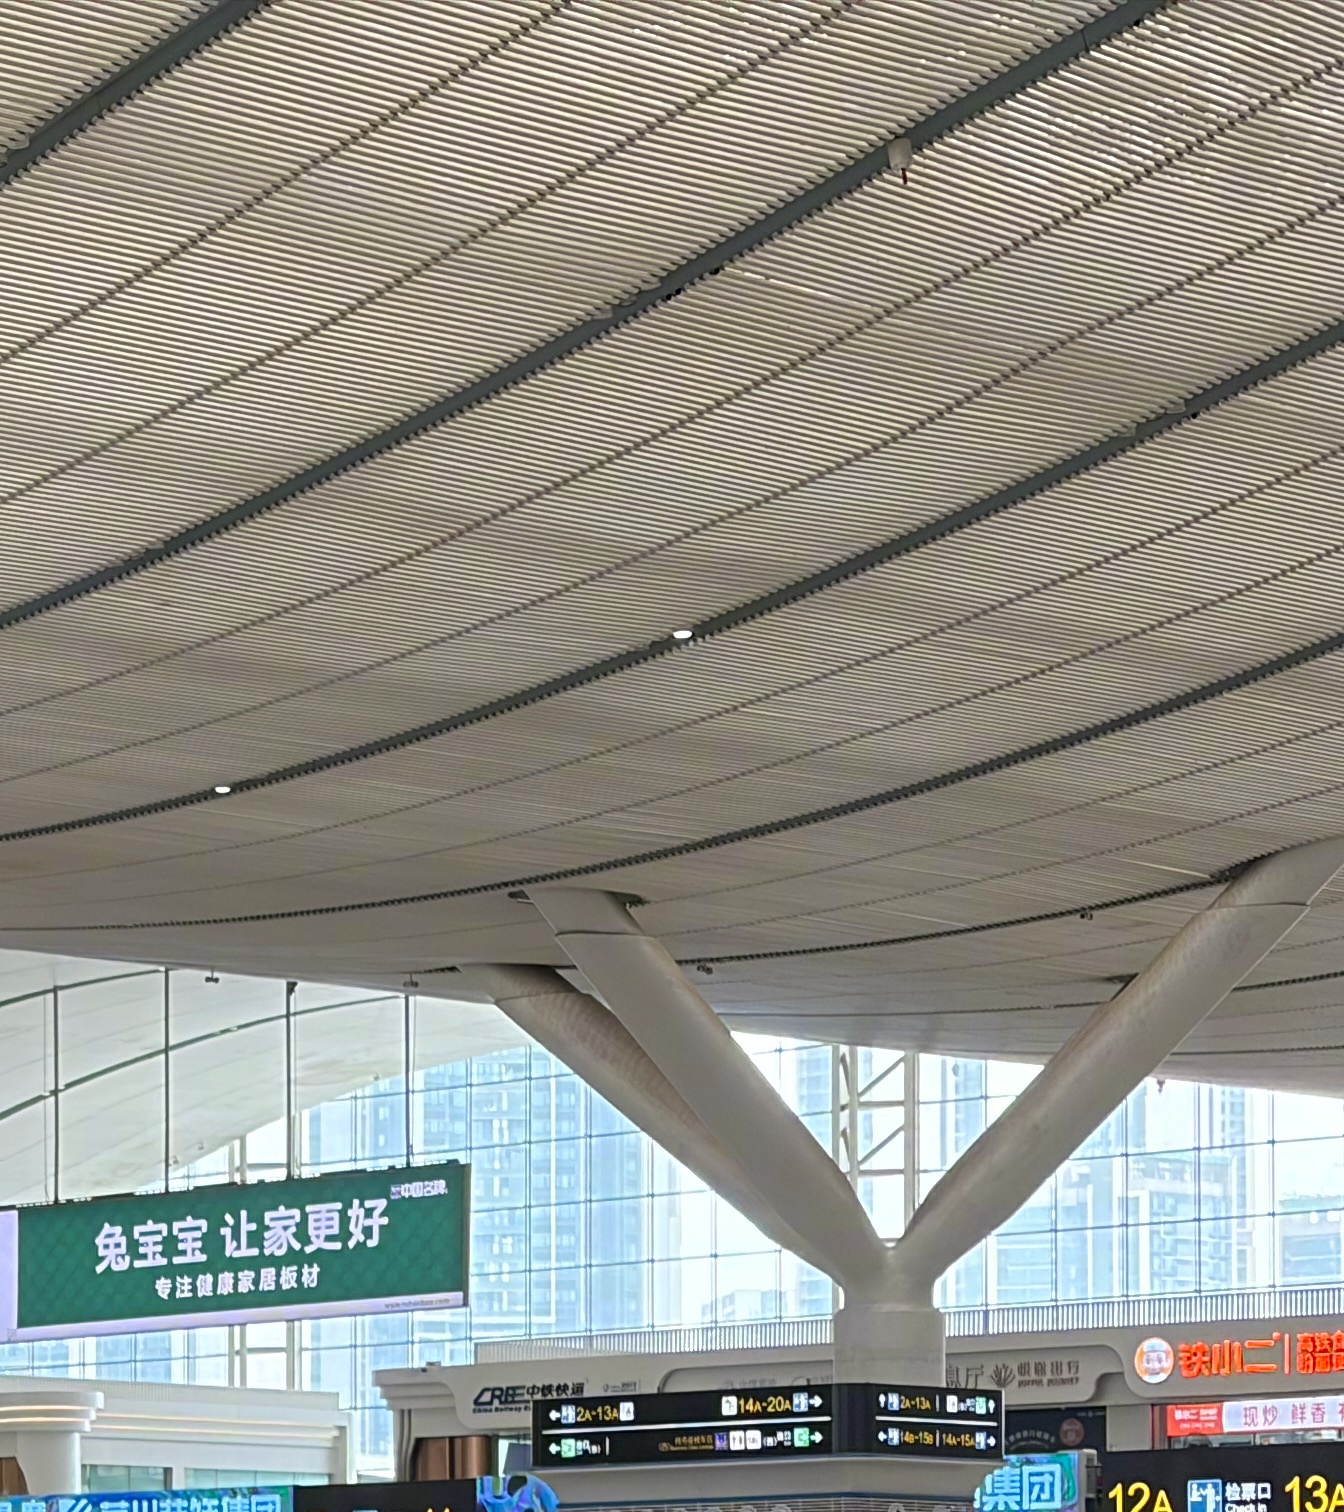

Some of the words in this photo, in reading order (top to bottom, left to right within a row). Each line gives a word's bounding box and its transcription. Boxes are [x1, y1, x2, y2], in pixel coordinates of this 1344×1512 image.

[94, 1215, 208, 1274] 兔宝宝
[220, 1198, 389, 1258] 让家更好
[155, 1263, 320, 1300] 专注健康家居板材
[1178, 1332, 1282, 1378] 铁小二
[526, 1383, 585, 1398] 中铁快运
[973, 1464, 1062, 1511] 集团
[1225, 1482, 1271, 1501] 检票口
